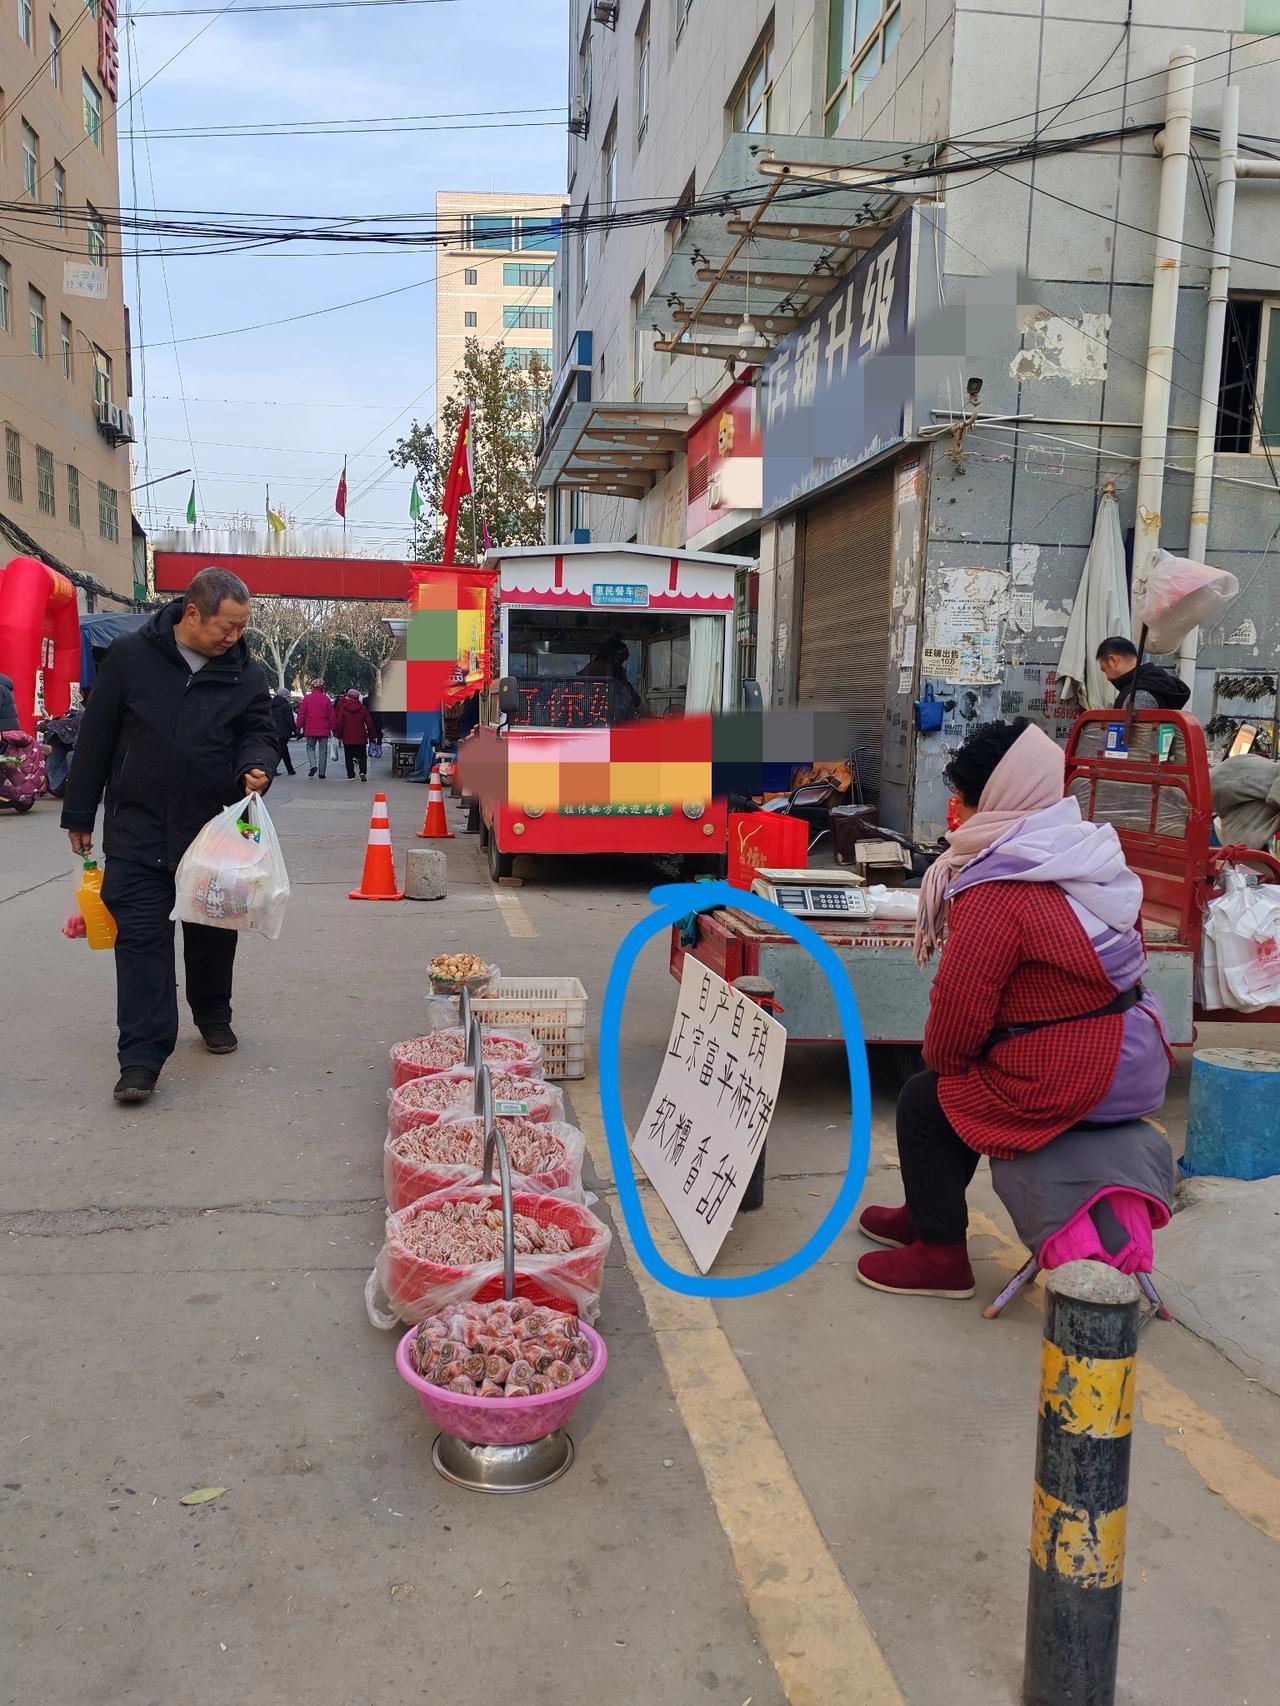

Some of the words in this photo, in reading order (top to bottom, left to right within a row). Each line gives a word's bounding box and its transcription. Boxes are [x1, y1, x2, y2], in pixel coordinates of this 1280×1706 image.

[767, 237, 898, 429] 店铺升级
[595, 585, 635, 596] 惠民餐车
[564, 803, 612, 815] 祖传秘方
[617, 803, 666, 816] 欢迎品尝
[697, 972, 770, 1070] 自产自销
[669, 1012, 774, 1156] 正宗富平柿饼
[648, 1093, 737, 1226] 软糯香甜
